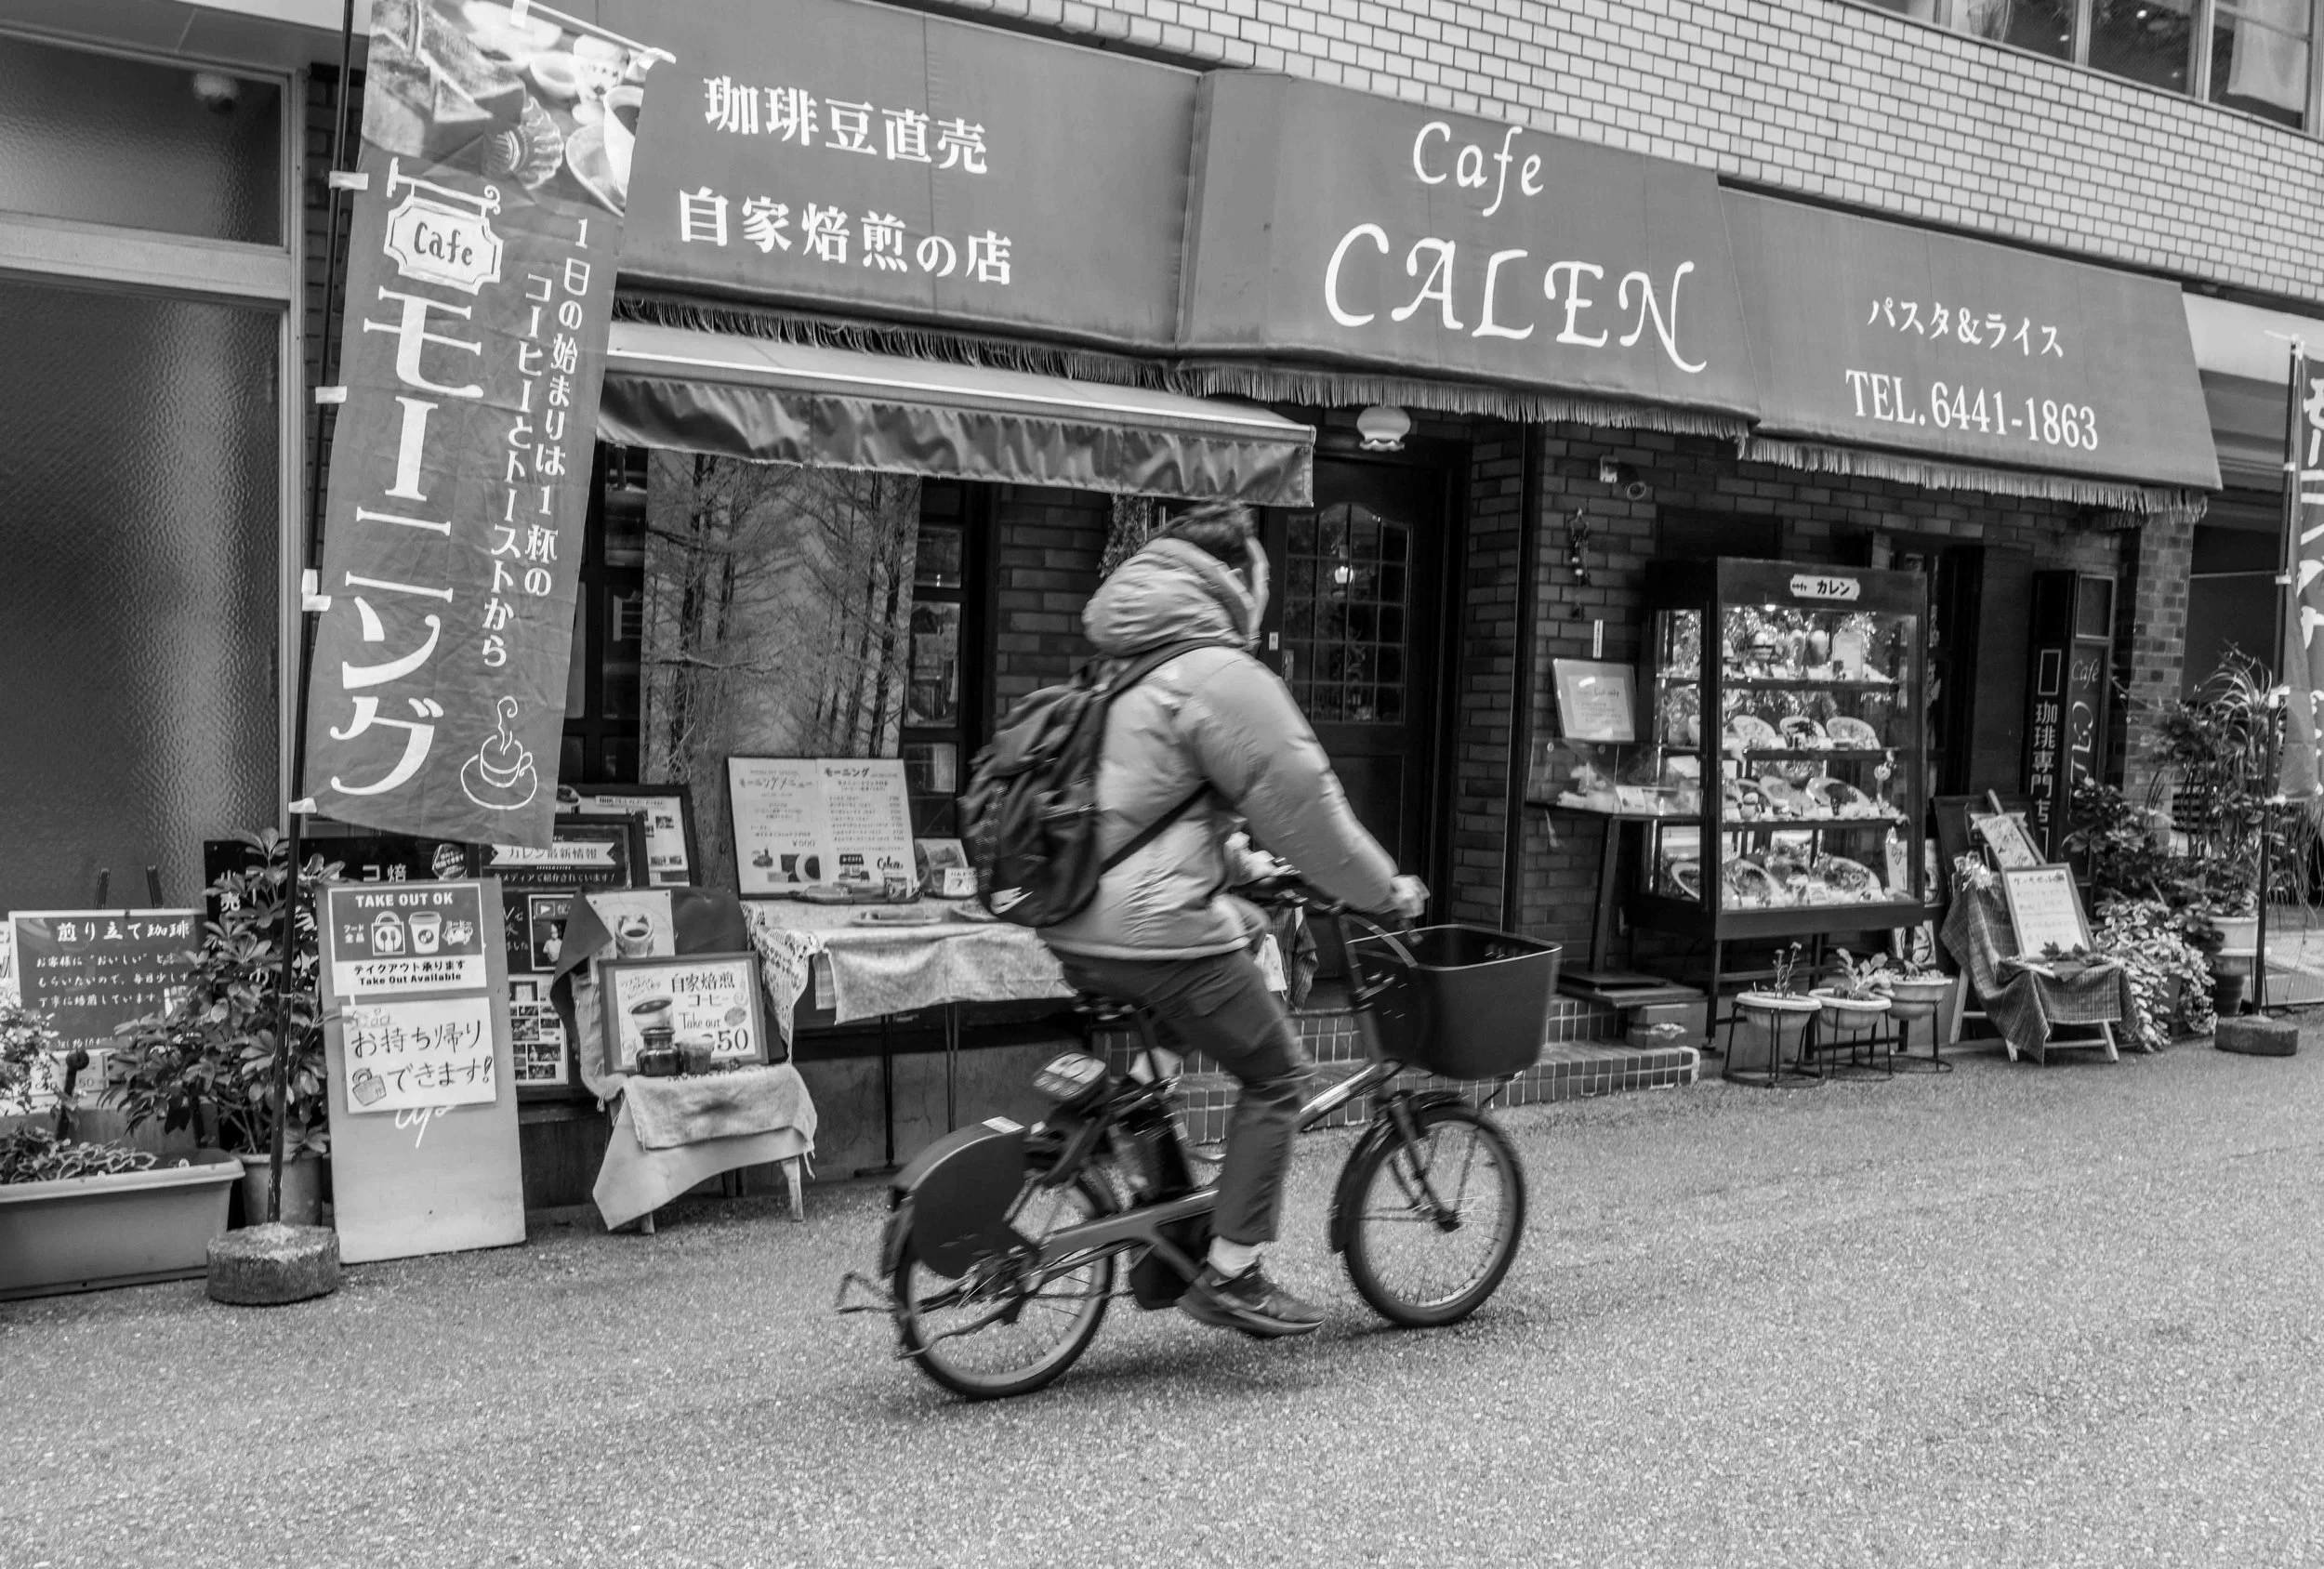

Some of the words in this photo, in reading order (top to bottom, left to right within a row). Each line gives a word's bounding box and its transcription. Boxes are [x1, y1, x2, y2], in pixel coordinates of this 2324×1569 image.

[704, 74, 987, 175] 珈琲豆直売
[1413, 121, 1544, 218] Cafe
[414, 221, 474, 267] Cafe
[680, 186, 1012, 286] 自家焙煎の店
[1324, 223, 1708, 373] CALEN
[1867, 296, 2064, 358] パスタ&ライス
[1845, 369, 2098, 451] TEL.6441-1863
[482, 272, 553, 667] コーヒーとトーストから
[329, 284, 484, 797] モーニング
[1816, 579, 1850, 597] カレン
[355, 893, 395, 908] TAKE
[399, 892, 429, 906] OUT
[432, 891, 454, 905] OK
[354, 959, 466, 976] テイクアウト承ります
[359, 976, 386, 986] Take
[389, 975, 407, 984] Out
[411, 971, 462, 983] Available
[671, 969, 735, 995] 自家焙煎
[350, 1019, 482, 1059] お持ち帰り
[678, 1011, 703, 1030] Take
[705, 1018, 720, 1029] out
